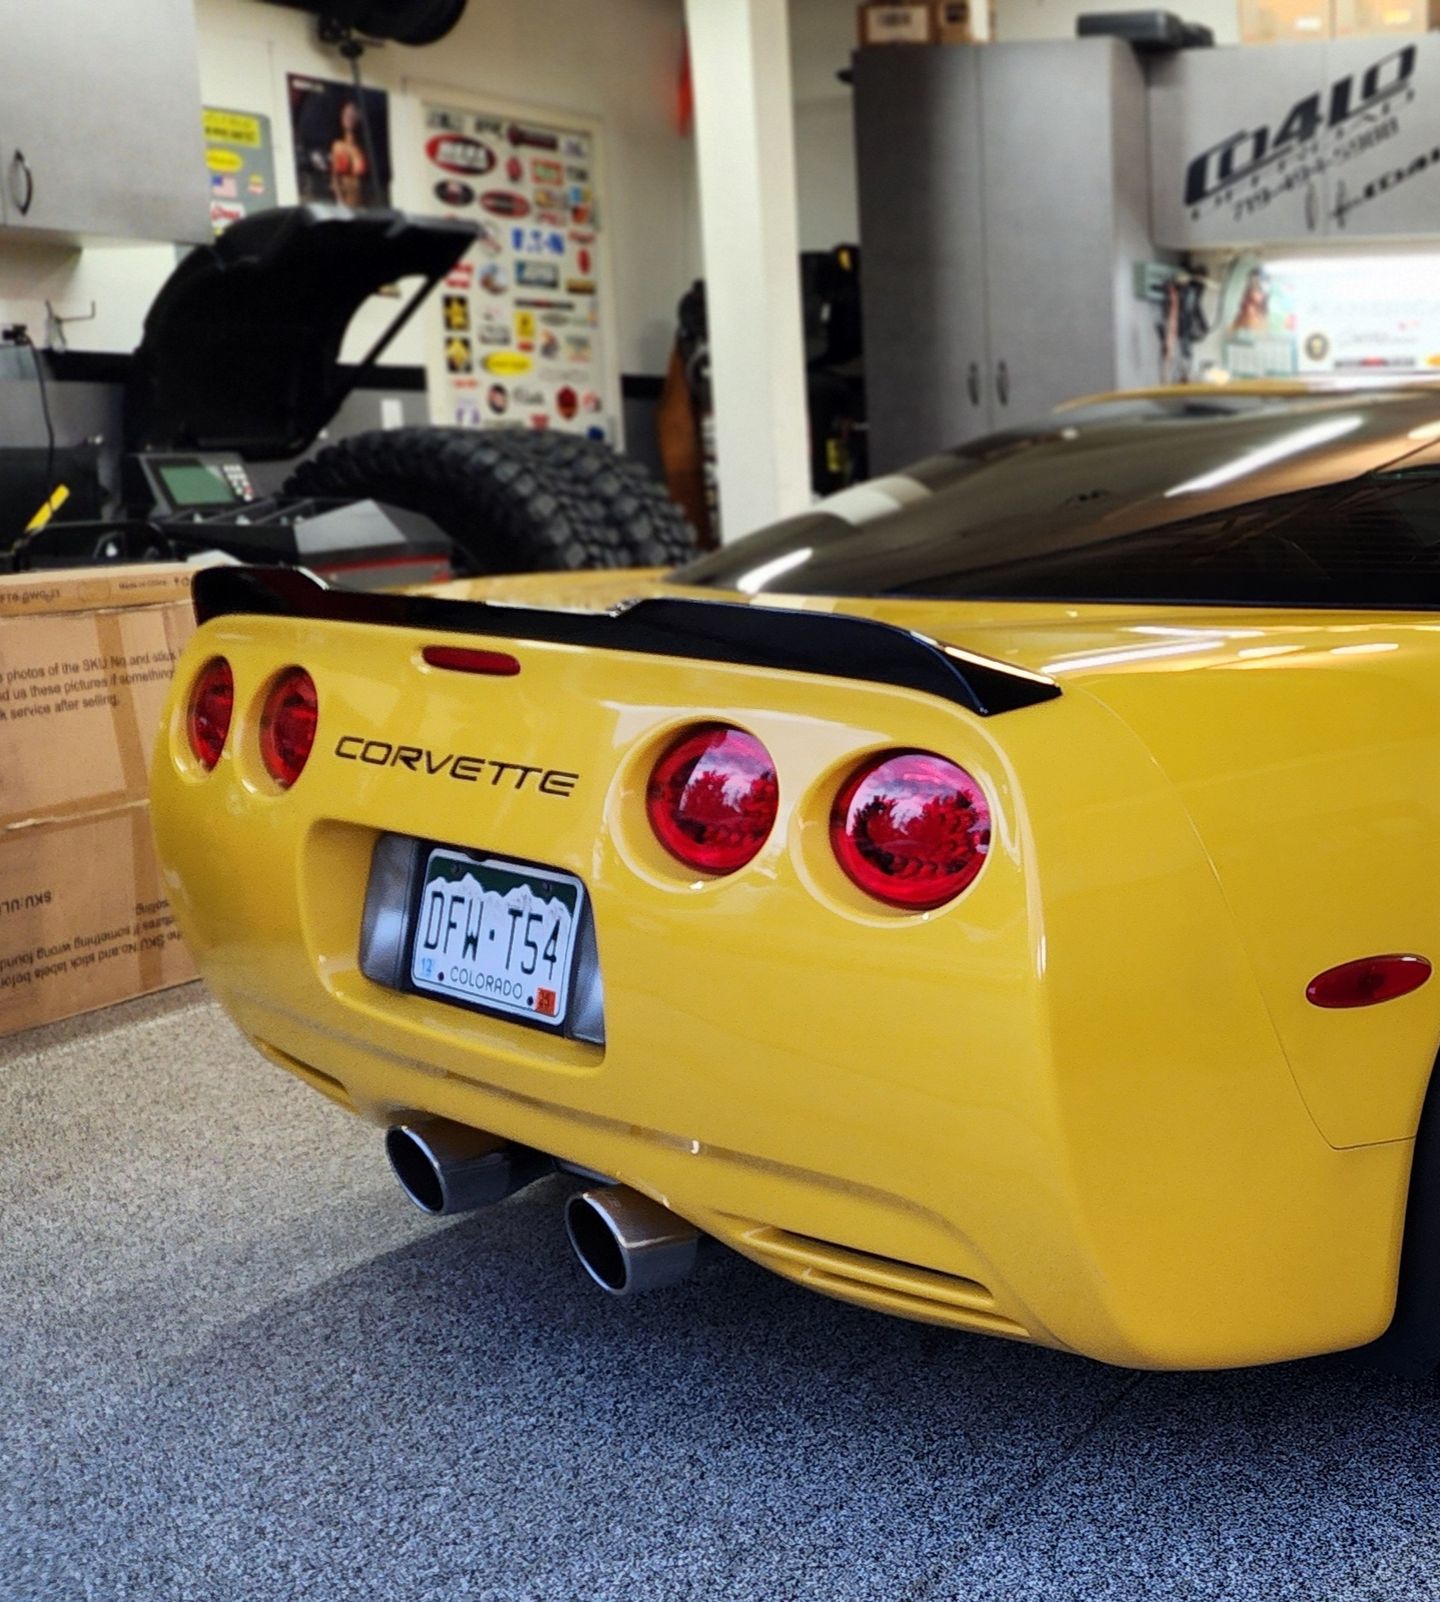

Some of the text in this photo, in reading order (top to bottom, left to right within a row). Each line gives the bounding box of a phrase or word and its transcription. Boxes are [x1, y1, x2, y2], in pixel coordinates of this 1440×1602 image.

[6, 667, 46, 685] photos
[47, 662, 59, 676] of
[61, 662, 80, 675] the
[82, 656, 108, 673] SKU
[13, 688, 28, 700] us
[29, 684, 61, 698] these
[64, 677, 108, 696] pictures
[10, 704, 51, 720] service
[54, 698, 79, 713] after
[335, 735, 580, 797] CORVETTE
[0, 890, 52, 914] SKU:UL
[36, 943, 71, 960] wrong
[450, 966, 523, 1000] COLORADO
